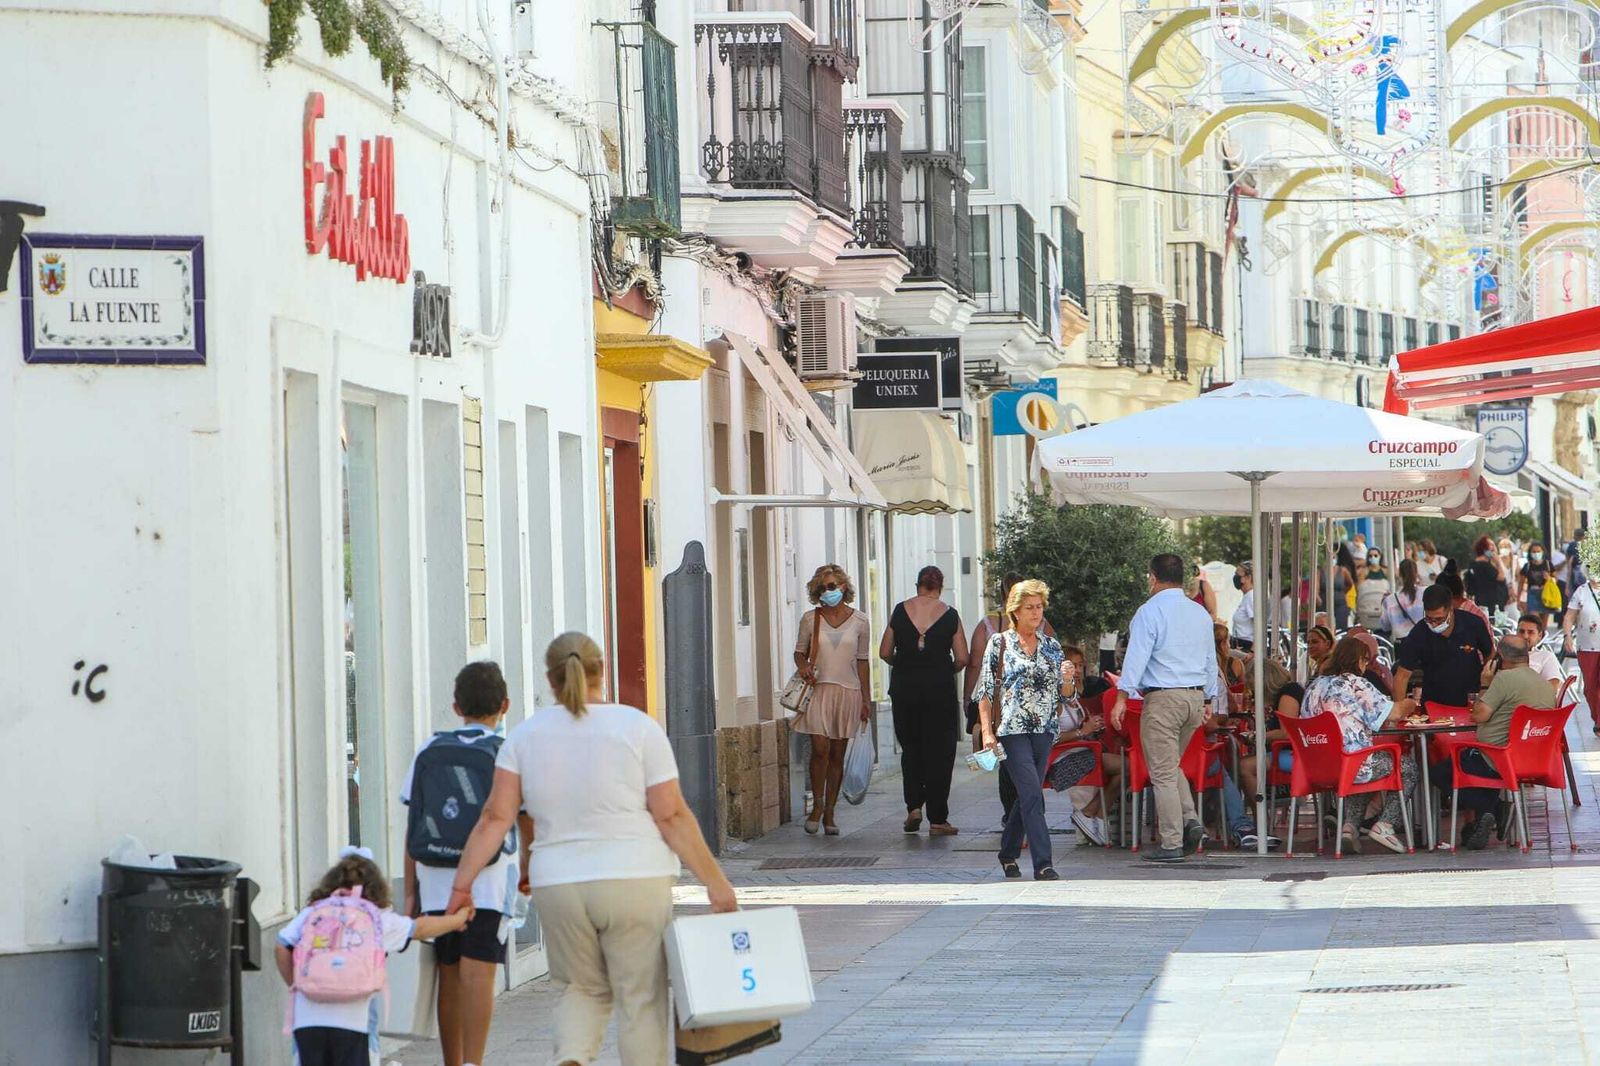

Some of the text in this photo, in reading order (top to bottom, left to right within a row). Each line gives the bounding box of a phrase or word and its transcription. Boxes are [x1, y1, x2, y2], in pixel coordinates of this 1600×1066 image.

[88, 267, 139, 288] CALLE
[70, 302, 161, 323] LA FUENTE
[876, 385, 919, 396] UNISEX
[1480, 412, 1524, 422] PHILIPS
[1368, 440, 1457, 456] Cruzcampo
[1389, 458, 1441, 468] ESPECIAL
[1362, 486, 1447, 503] Cruzcampo
[743, 969, 756, 991] 5
